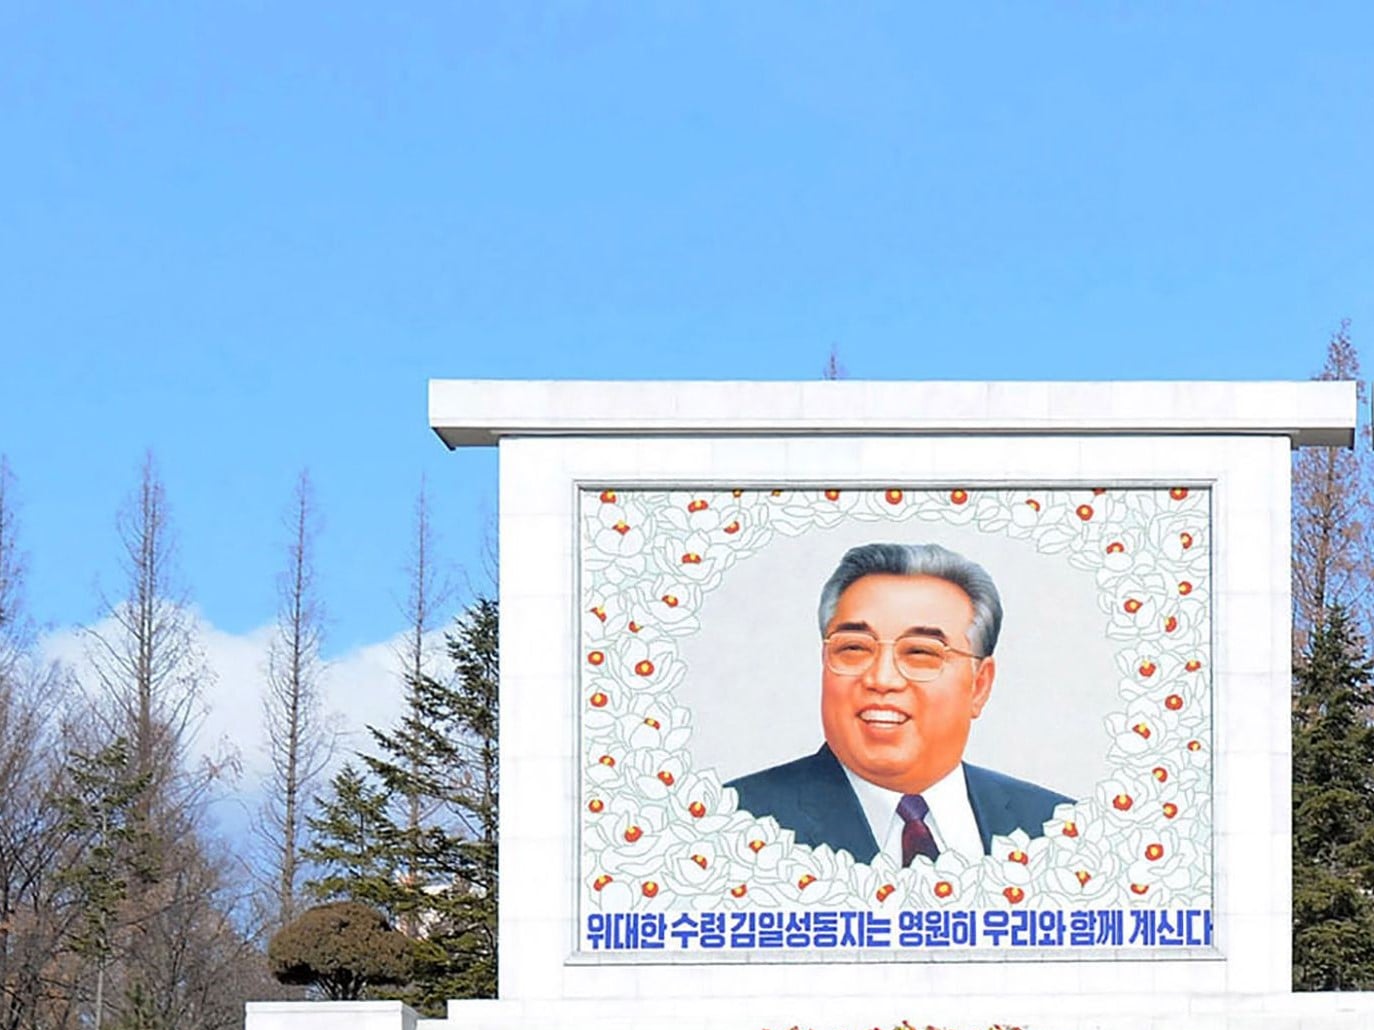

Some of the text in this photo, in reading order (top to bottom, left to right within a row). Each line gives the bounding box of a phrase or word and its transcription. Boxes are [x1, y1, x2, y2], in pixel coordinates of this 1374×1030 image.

[587, 909, 1214, 949] 위대한 수령 김일성동지는 영원히 우리와 함께 계신다
